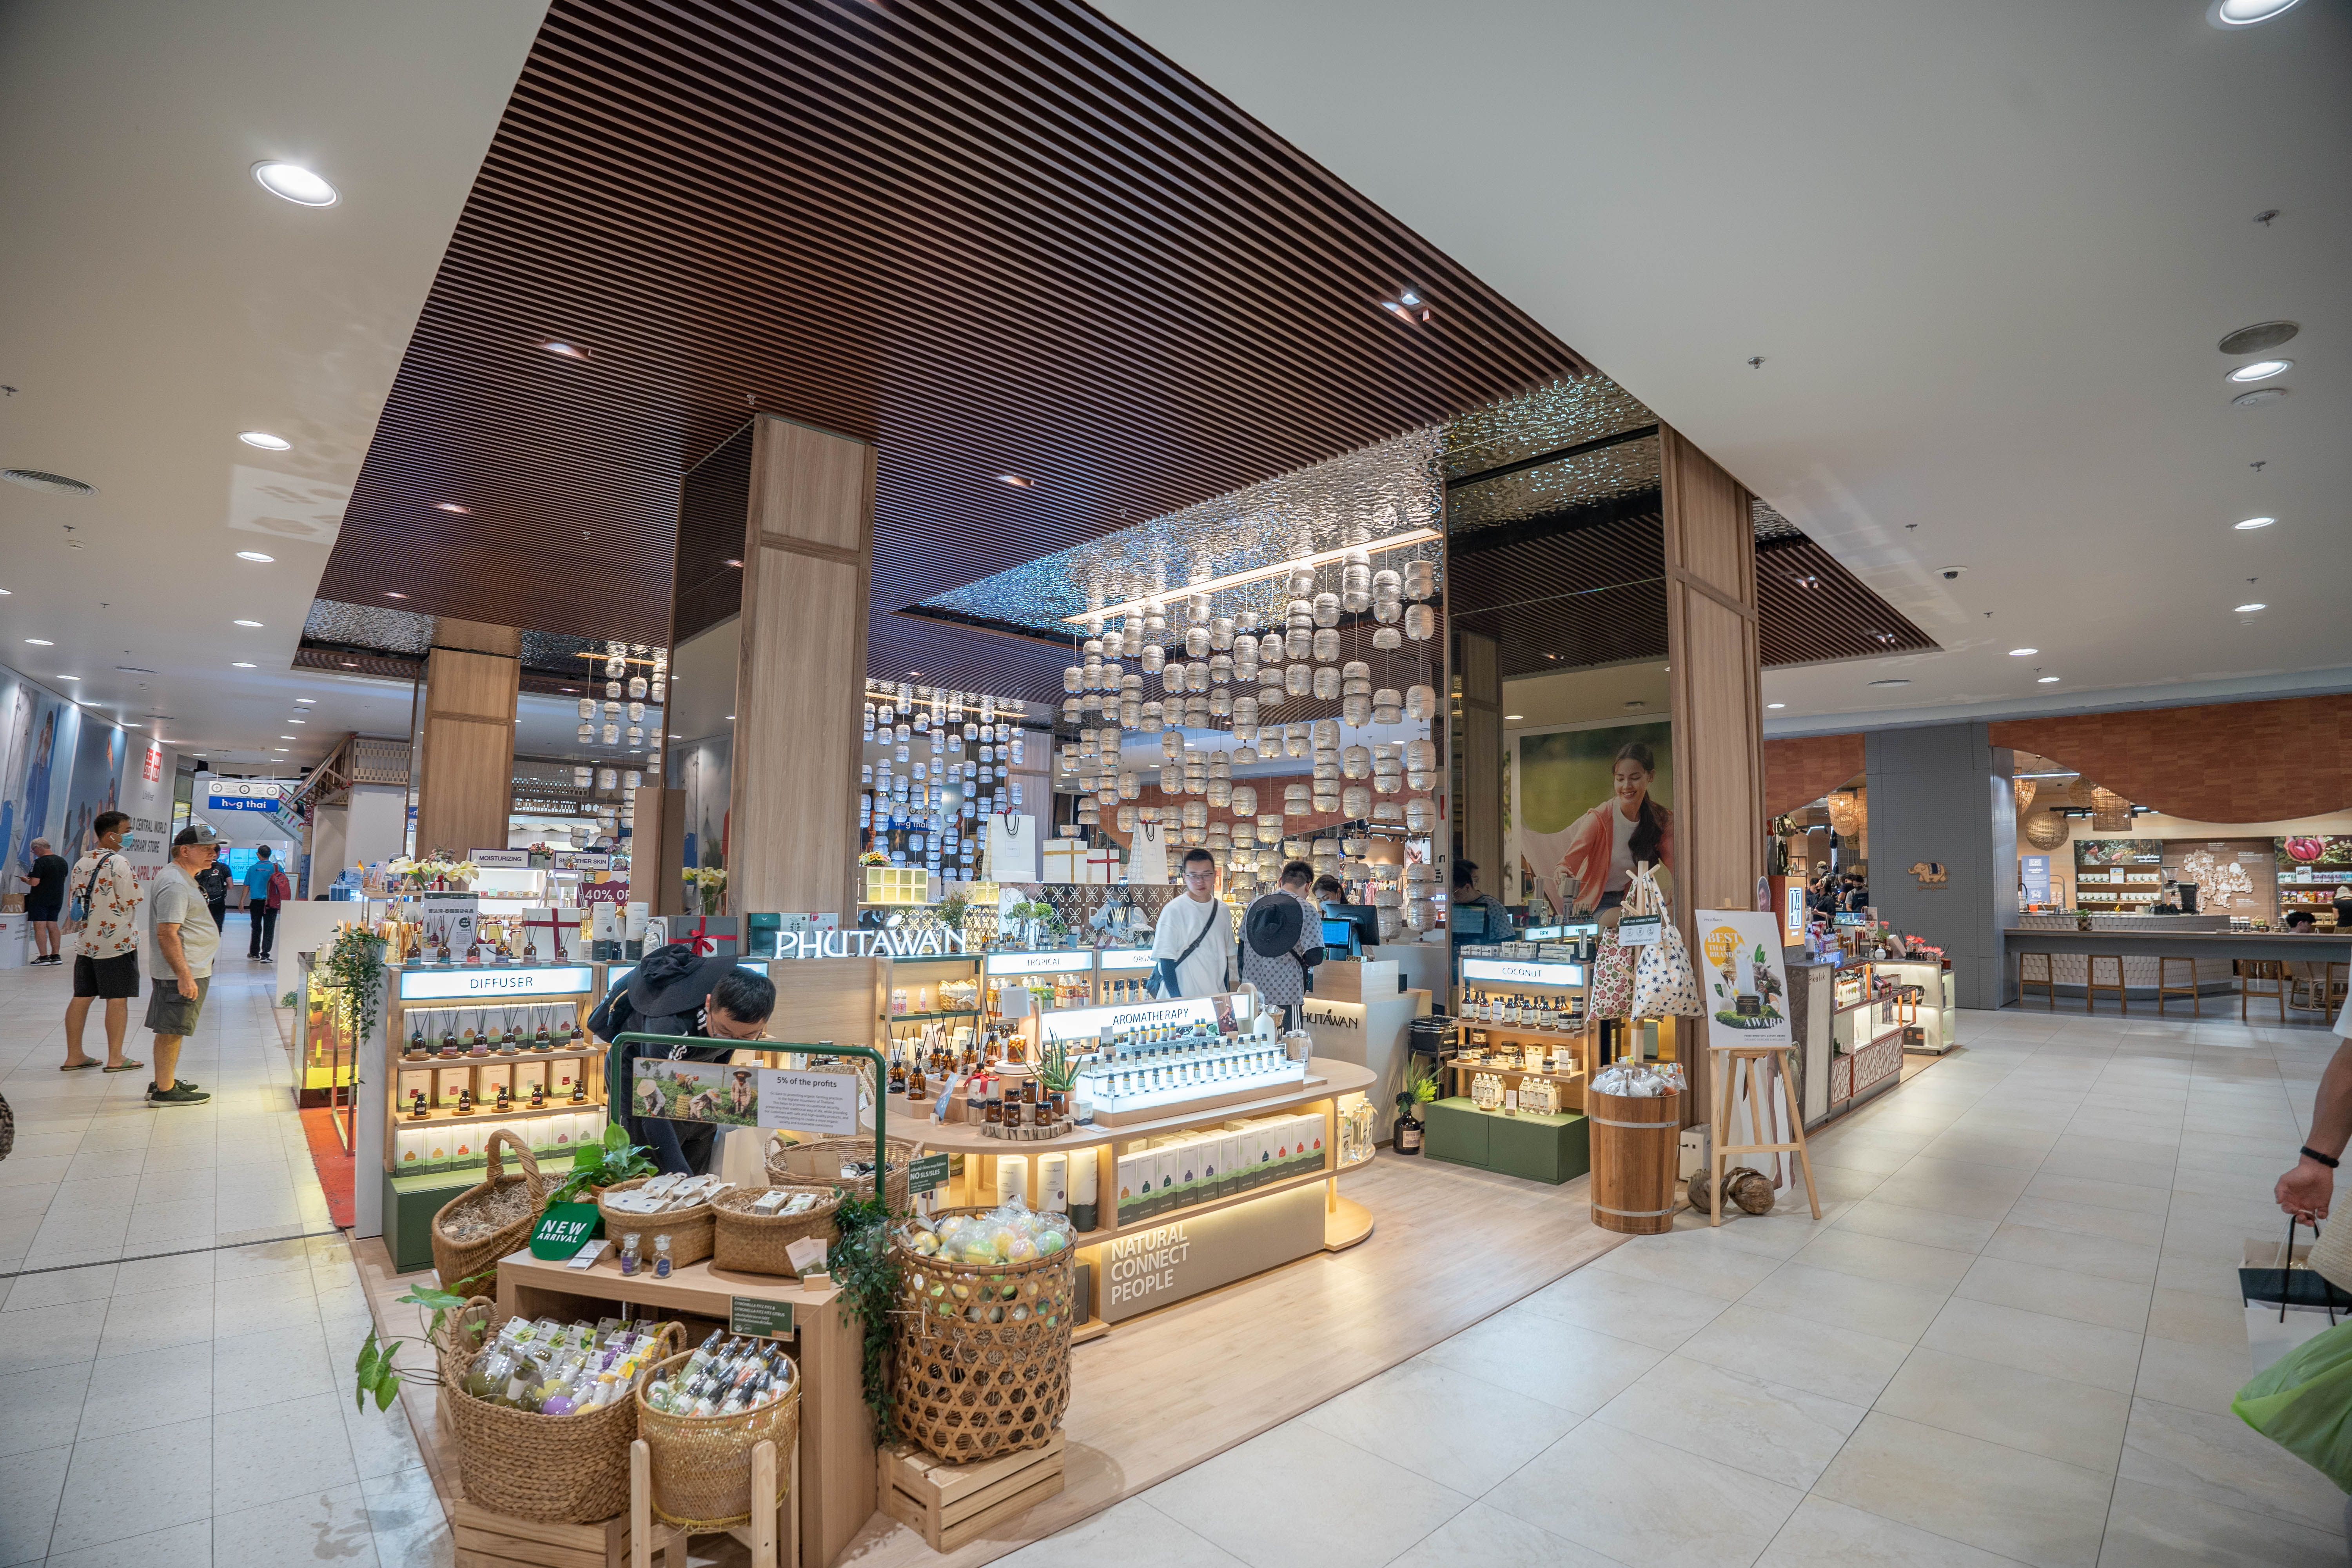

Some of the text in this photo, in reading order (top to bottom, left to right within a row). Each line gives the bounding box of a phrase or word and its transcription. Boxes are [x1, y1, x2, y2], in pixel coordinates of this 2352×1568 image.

[136, 818, 153, 832] CENTRAL
[154, 821, 167, 834] WORLD
[147, 840, 160, 853] STORE
[137, 866, 150, 880] APRIL
[585, 889, 613, 900] 40%
[774, 929, 967, 959] PHUTAWAN
[1707, 933, 1740, 944] BEST
[1027, 958, 1061, 966] TROPICAL
[1502, 967, 1542, 978] COCONUT
[470, 976, 533, 989] DIFFUSER
[1113, 1008, 1189, 1025] AROMATHERAPY
[1744, 1018, 1785, 1027] AWARD
[910, 1169, 940, 1180] NO SLS/SLES
[541, 1220, 588, 1235] NEW
[536, 1233, 577, 1243] ARRIVAL
[1112, 1224, 1188, 1261] NATURAL
[1111, 1242, 1190, 1282] CONNECT
[1112, 1269, 1173, 1305] PEOPLE
